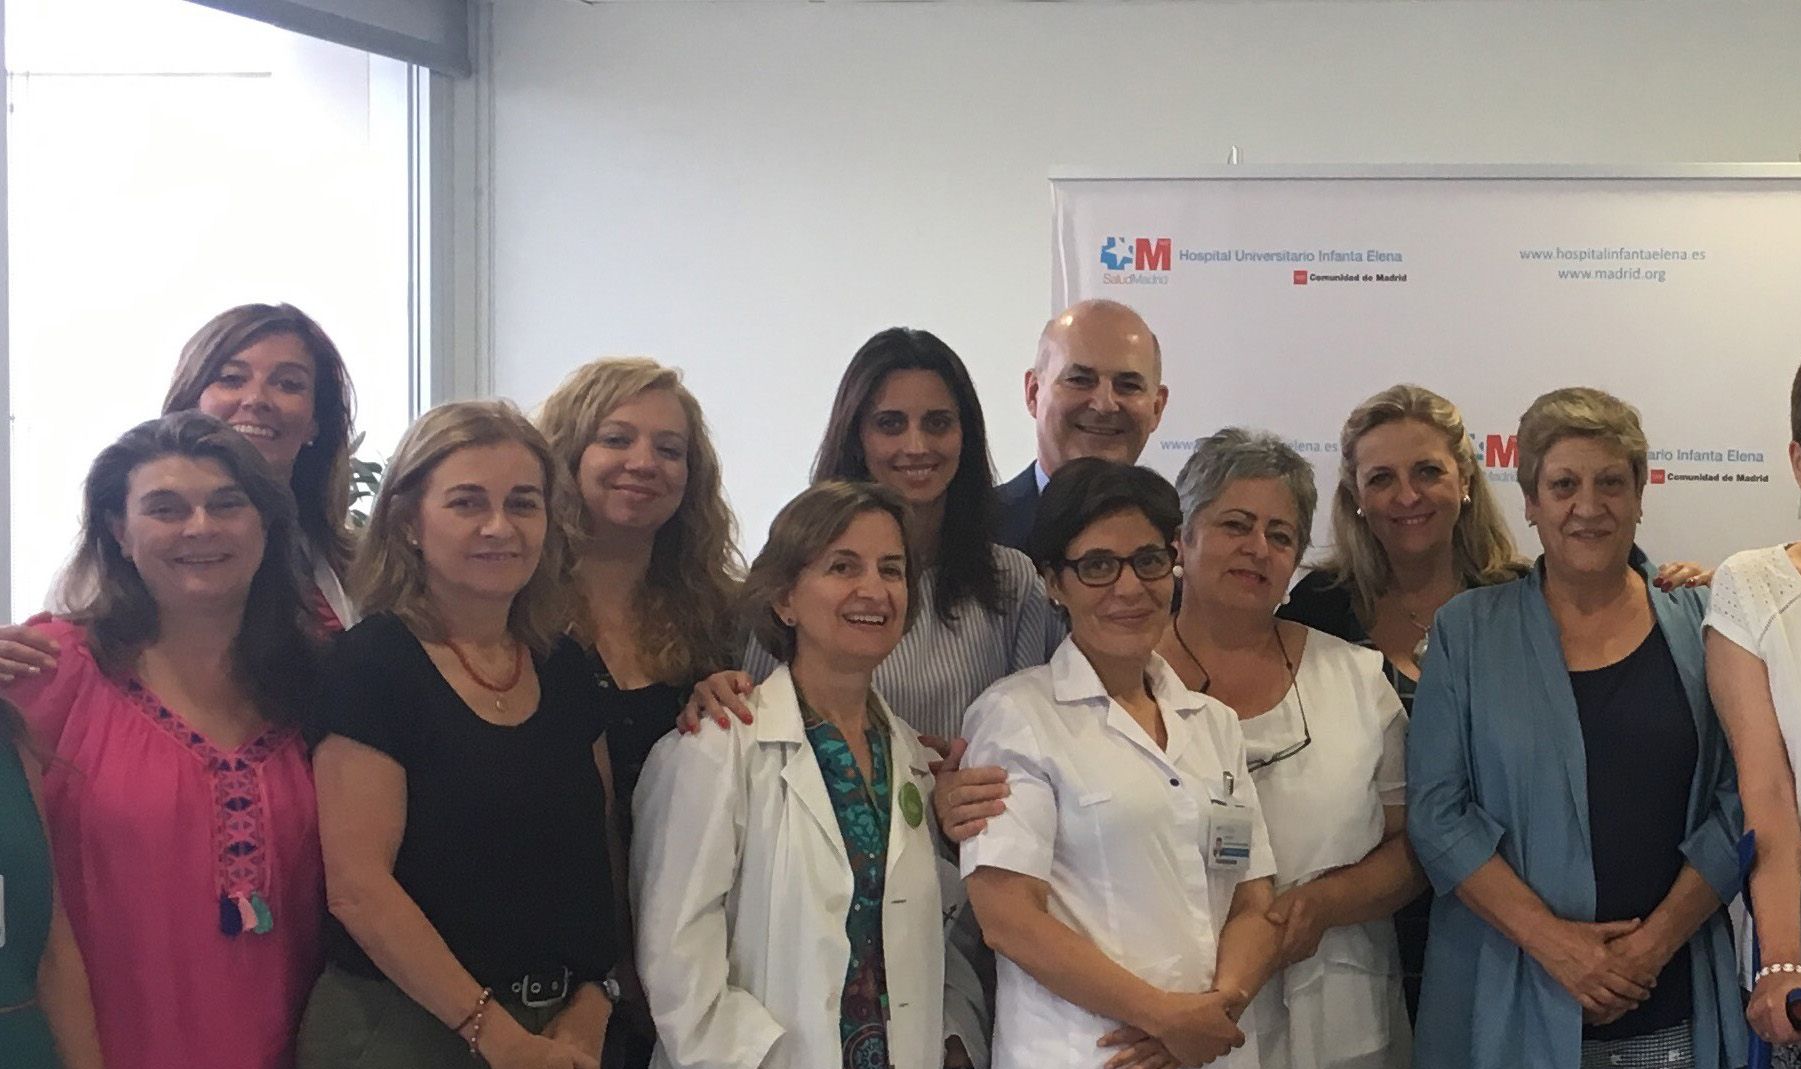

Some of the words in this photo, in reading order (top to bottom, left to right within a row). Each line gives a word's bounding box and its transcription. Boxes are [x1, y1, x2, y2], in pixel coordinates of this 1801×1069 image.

[1179, 249, 1231, 265] Hospital
[1236, 249, 1315, 263] Universitario
[1318, 250, 1363, 263] Infanta
[1366, 250, 1403, 263] Elena
[1519, 247, 1706, 264] www.hospitalinfantaelena.es
[1309, 273, 1359, 283] Comunidad
[1362, 273, 1373, 282] de
[1376, 273, 1407, 283] Madrid
[1558, 267, 1666, 283] www.madrid.org
[1677, 449, 1723, 462] Infanta
[1727, 450, 1764, 462] Elena
[1667, 472, 1719, 482] Comunidad
[1722, 473, 1733, 482] de
[1736, 474, 1769, 483] Madrid
